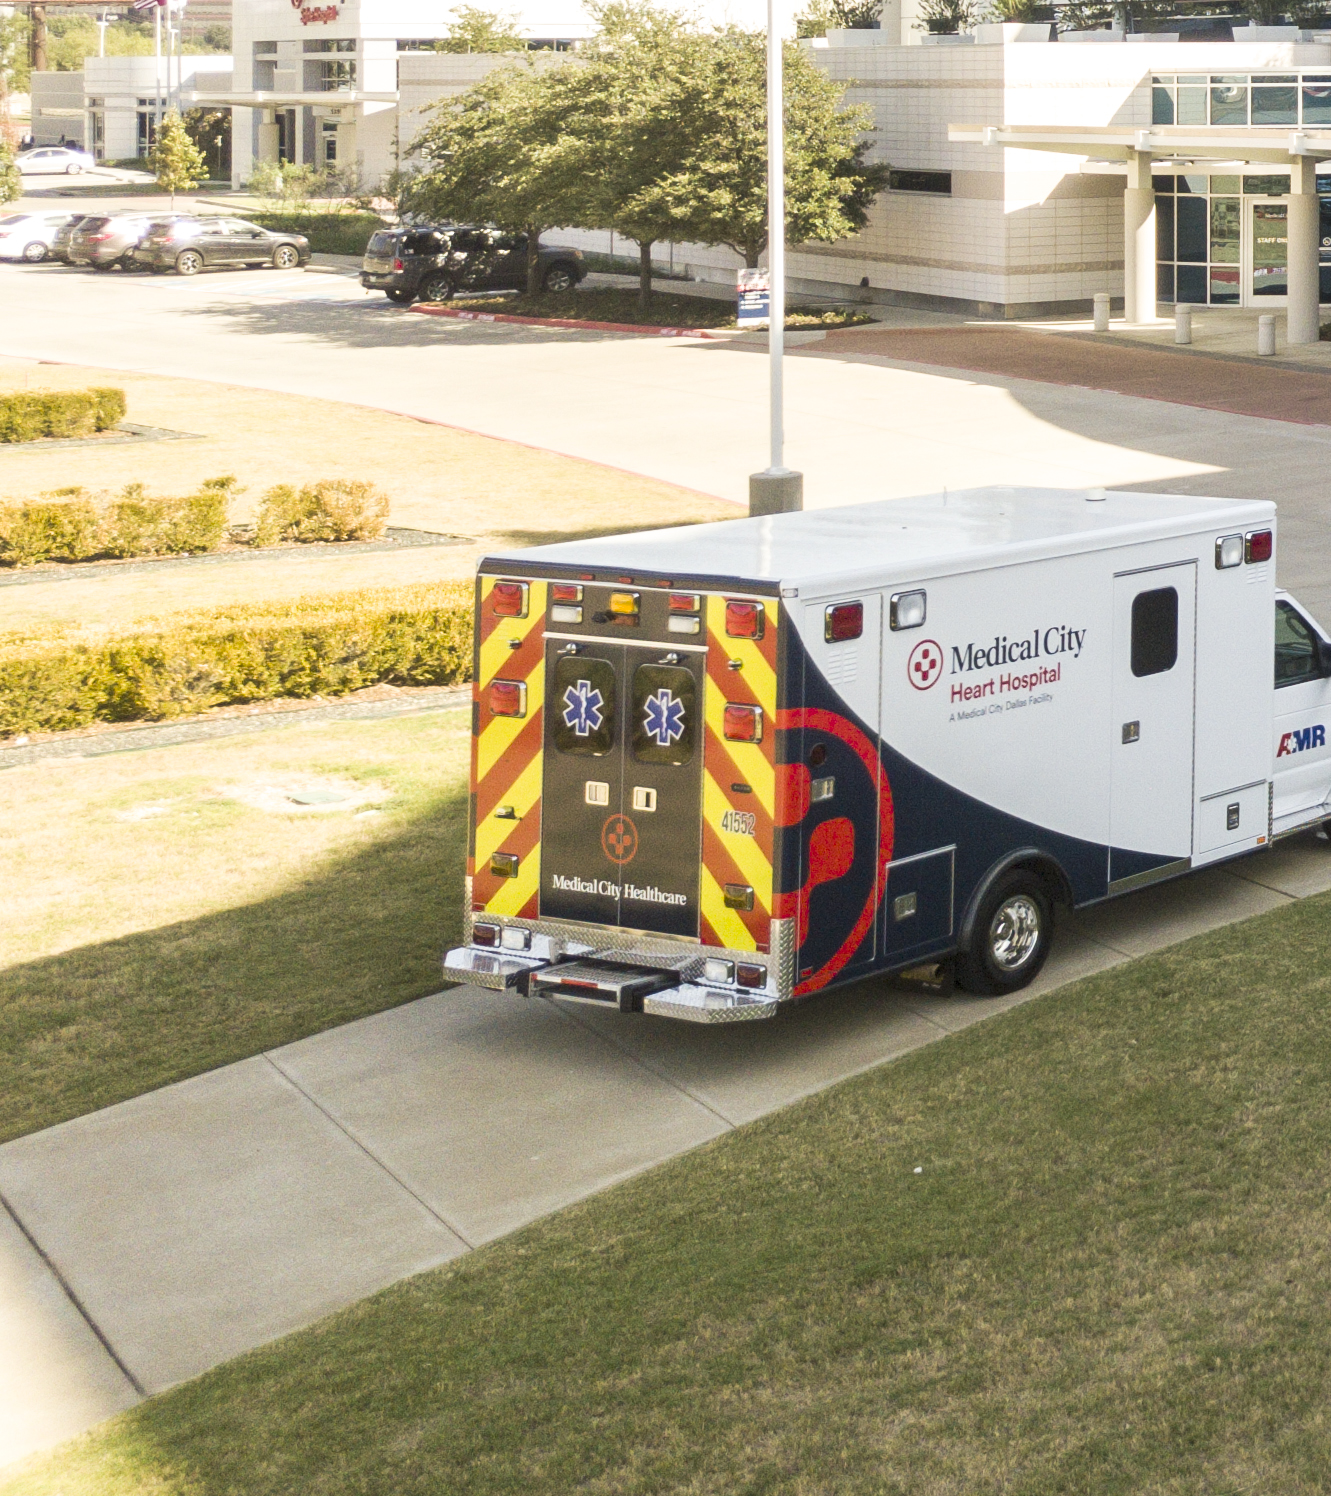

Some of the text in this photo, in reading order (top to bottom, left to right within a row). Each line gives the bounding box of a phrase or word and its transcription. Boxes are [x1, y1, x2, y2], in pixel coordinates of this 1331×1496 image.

[950, 625, 1087, 675] Medical City
[950, 662, 1061, 703] Heart Hospital
[949, 692, 1054, 723] A Medical City Dallas Facility
[1276, 724, 1326, 758] AMR
[721, 810, 756, 838] 41552
[552, 874, 687, 906] Medical City Healthcare
